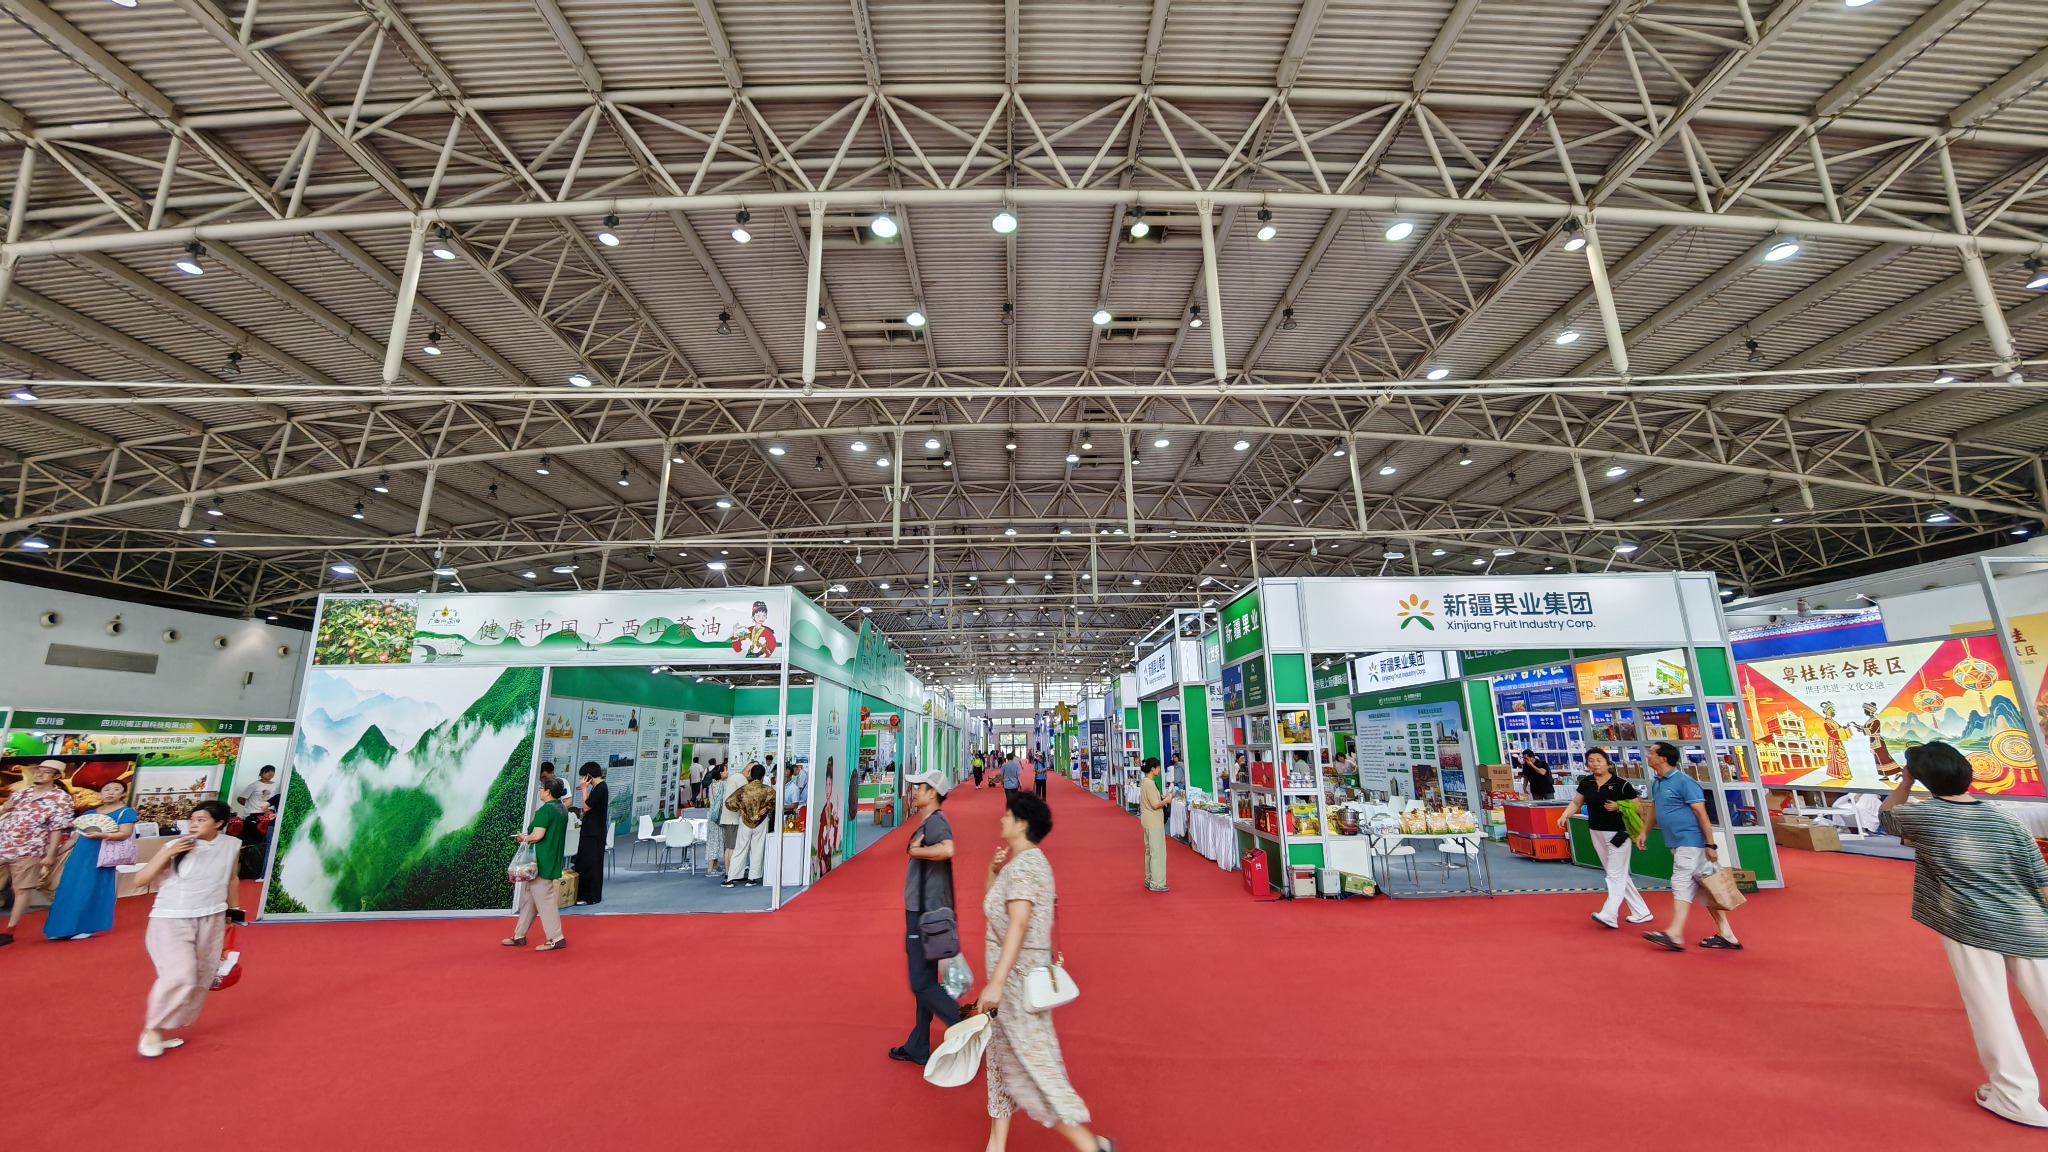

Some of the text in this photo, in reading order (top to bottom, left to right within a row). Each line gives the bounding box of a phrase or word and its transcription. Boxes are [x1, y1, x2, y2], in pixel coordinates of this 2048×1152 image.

[1443, 592, 1593, 617] 新疆果业集团
[479, 616, 721, 642] 健康中国 广西山茶油
[1225, 608, 1259, 643] 新疆果业
[1446, 618, 1597, 633] Xinjiang Fruit Industry Corp.
[1379, 651, 1426, 674] 新疆果业集团
[1782, 656, 1907, 685] 粤桂综合展区
[1804, 680, 1886, 695] 携手共进·文化交融
[35, 717, 65, 726] 四川省
[257, 724, 278, 732] 北京市
